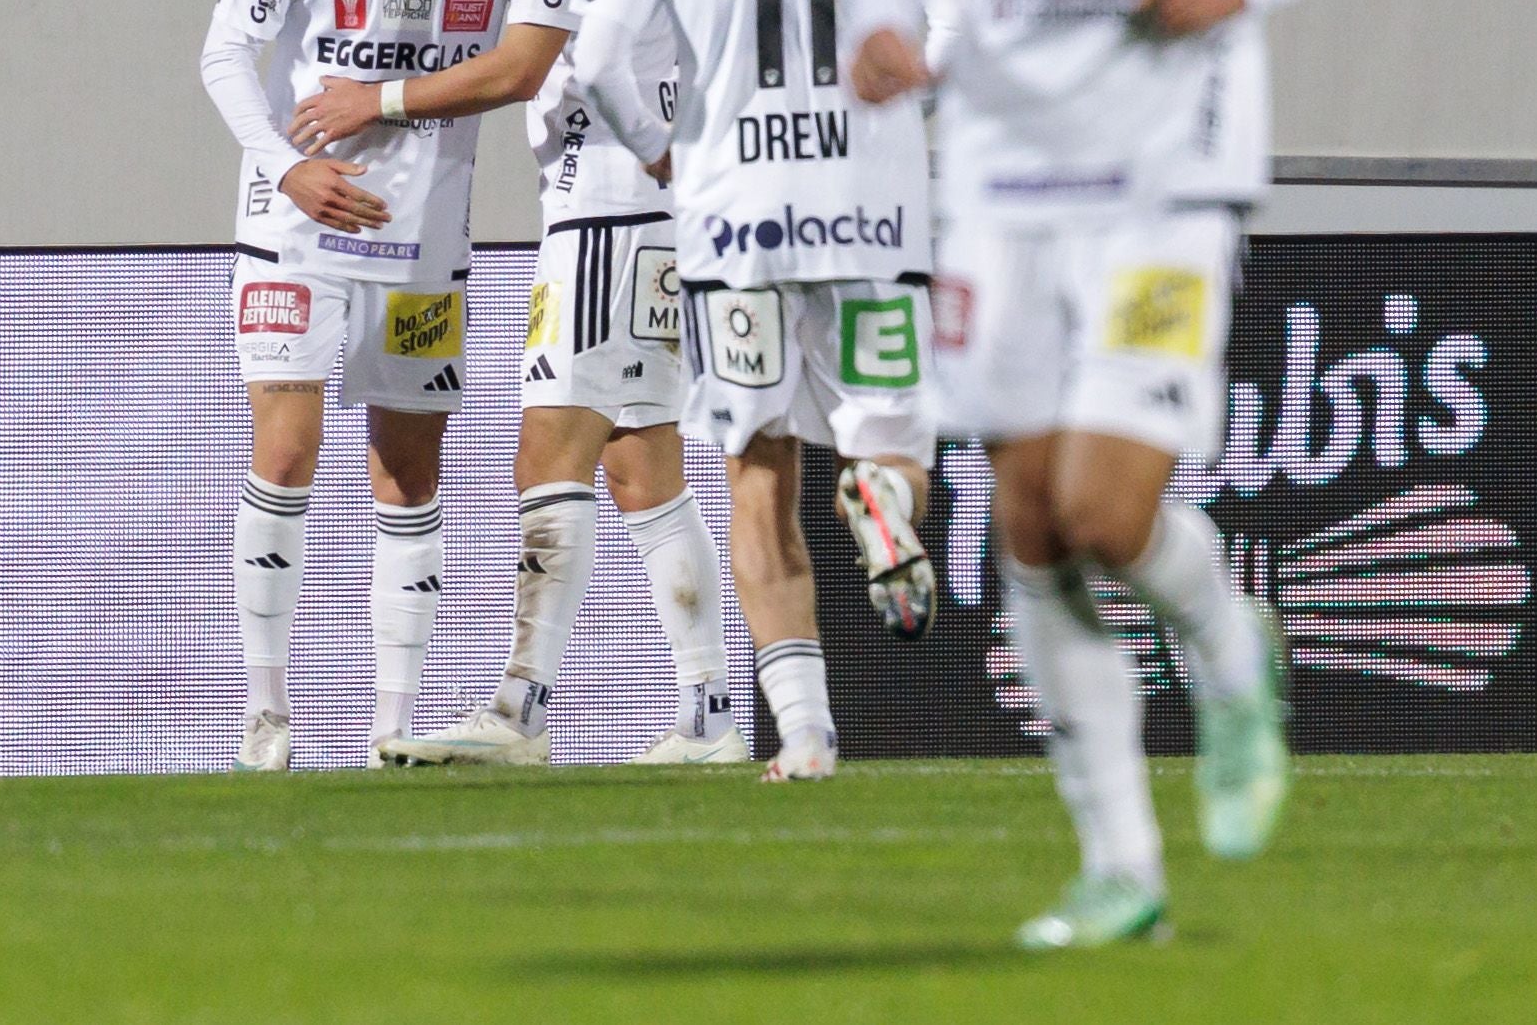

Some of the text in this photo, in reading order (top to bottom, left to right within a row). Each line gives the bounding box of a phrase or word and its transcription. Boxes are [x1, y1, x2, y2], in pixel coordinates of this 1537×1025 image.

[317, 37, 481, 73] EGGERGLAS
[738, 110, 849, 164] DREW
[242, 307, 301, 326] ZEITUNG
[247, 291, 296, 307] KLEINE
[400, 318, 449, 355] stopp
